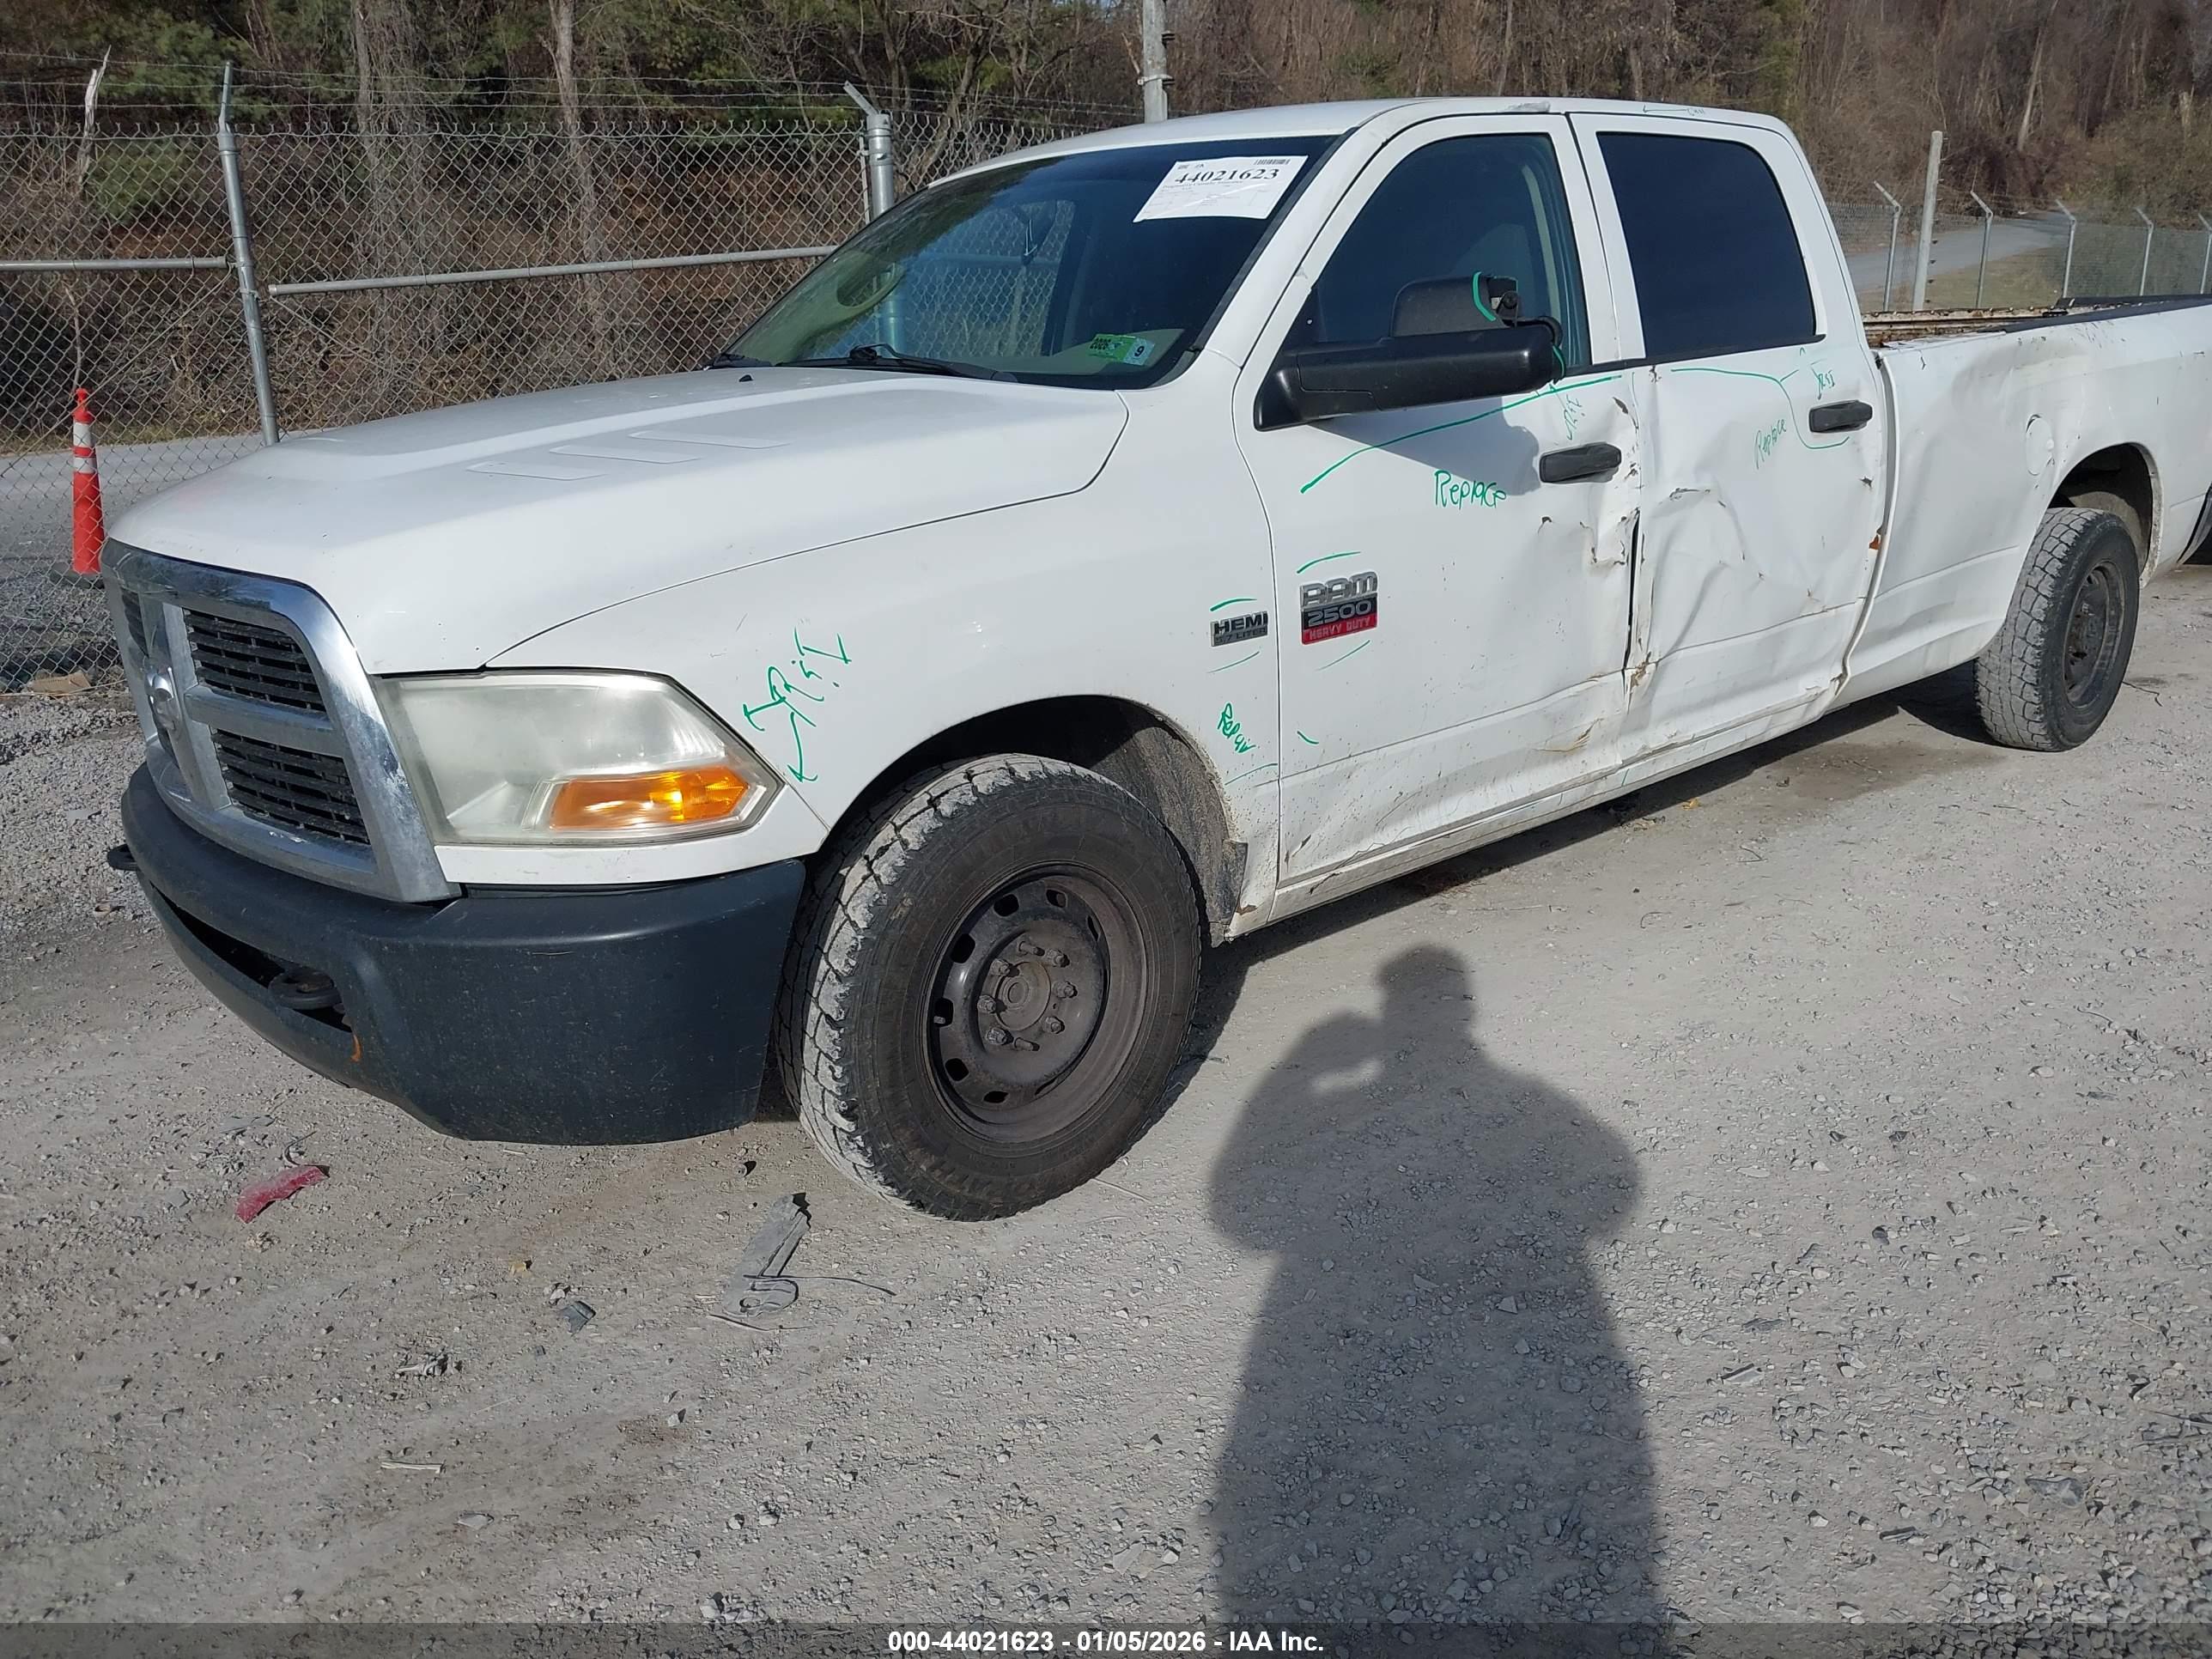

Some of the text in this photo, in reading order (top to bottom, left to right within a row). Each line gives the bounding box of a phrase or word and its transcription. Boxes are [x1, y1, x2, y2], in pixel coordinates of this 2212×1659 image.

[1174, 168, 1280, 184] 44021623
[1299, 571, 1378, 608] RAM
[1213, 611, 1268, 634] HEMI
[1308, 599, 1372, 627] 2500
[1215, 628, 1267, 645] 5.7 LITER
[1309, 617, 1371, 641] HEAVY DUTY
